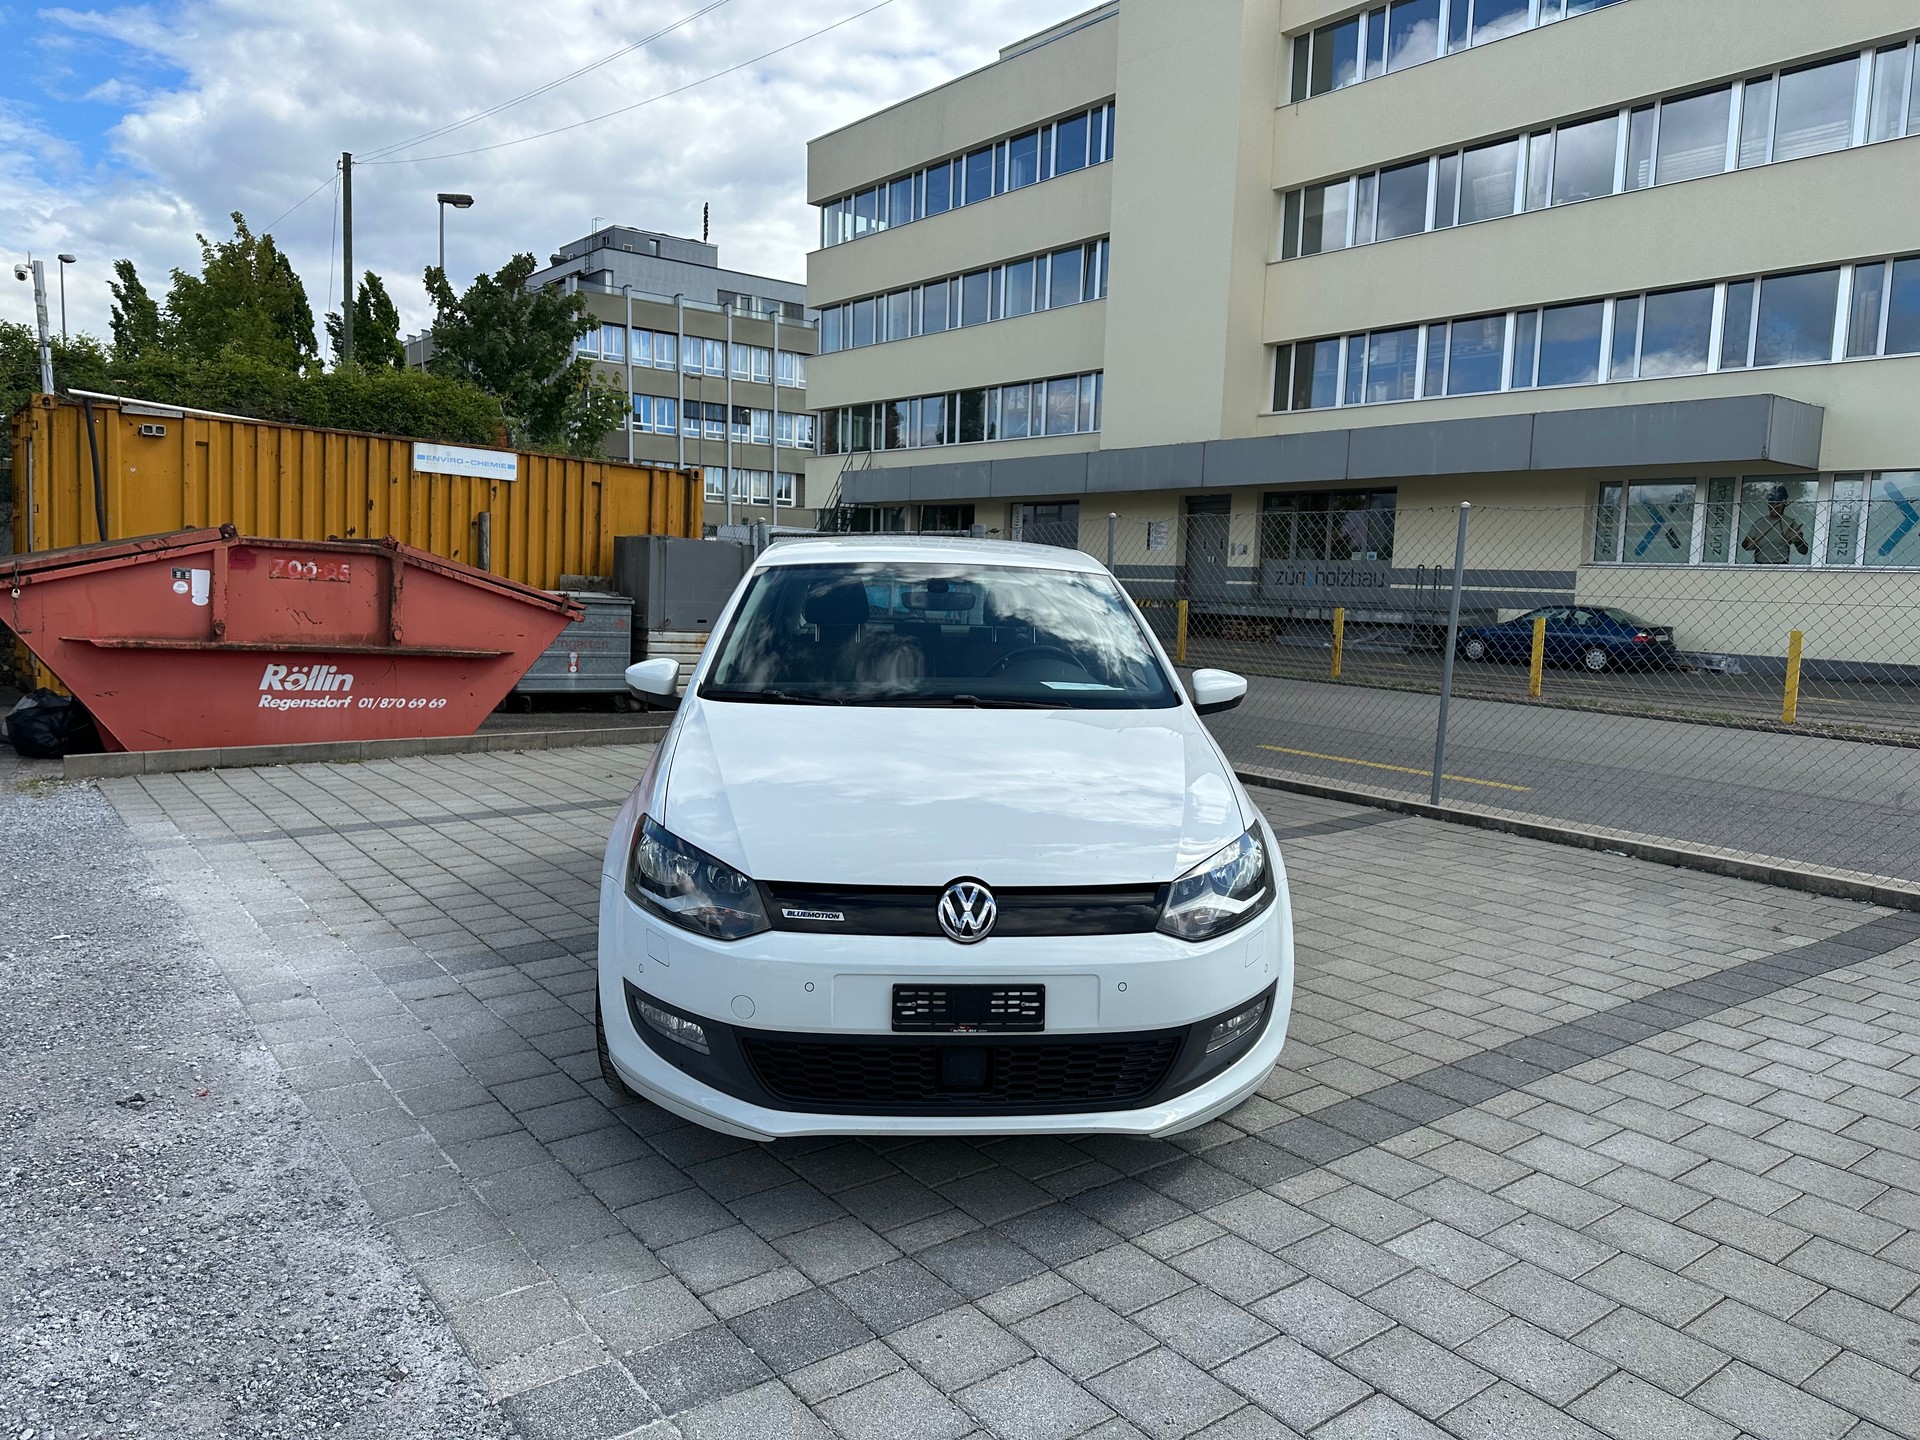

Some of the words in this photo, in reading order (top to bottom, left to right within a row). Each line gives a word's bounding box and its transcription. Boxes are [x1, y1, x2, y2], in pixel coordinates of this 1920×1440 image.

[259, 663, 354, 691] Röllin
[258, 694, 353, 711] Regensdorf
[357, 697, 406, 710] 01/870
[408, 698, 427, 709] 69
[428, 698, 447, 709] 69
[786, 910, 841, 919] BLUEMOTION
